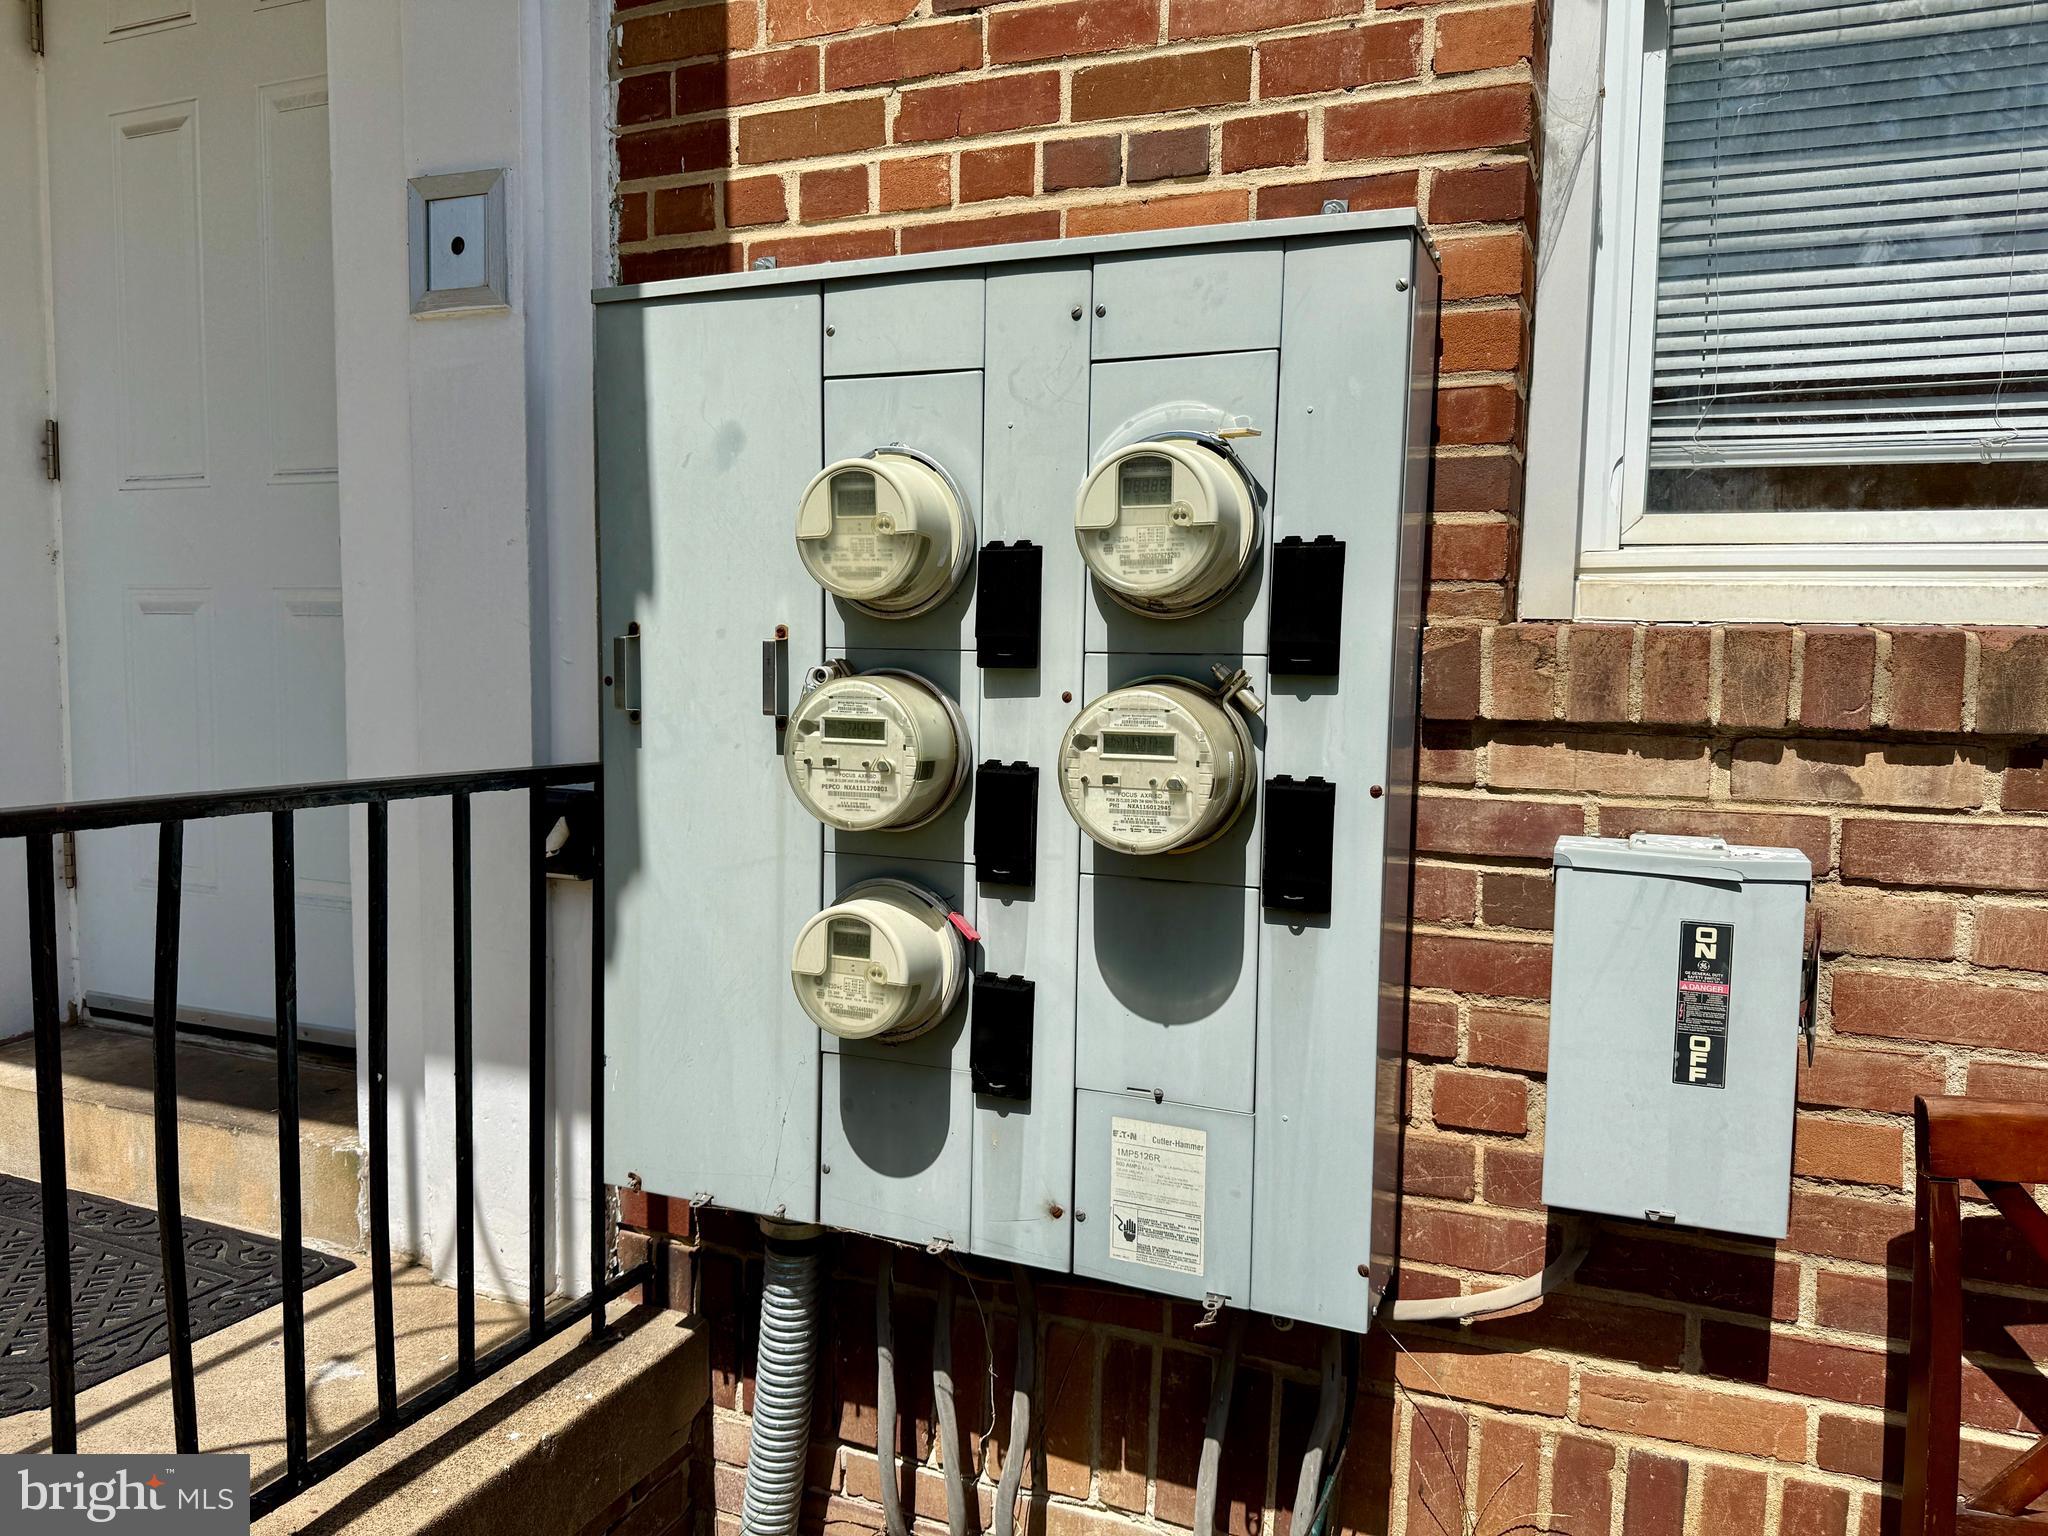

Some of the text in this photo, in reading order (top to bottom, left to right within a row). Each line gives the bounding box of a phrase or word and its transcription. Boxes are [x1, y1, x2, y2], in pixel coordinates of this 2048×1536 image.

[1694, 926, 1718, 960] ON
[1689, 983, 1724, 993] DANGER
[1688, 1035, 1711, 1082] OFF
[1117, 1147, 1161, 1162] 1MP5126R
